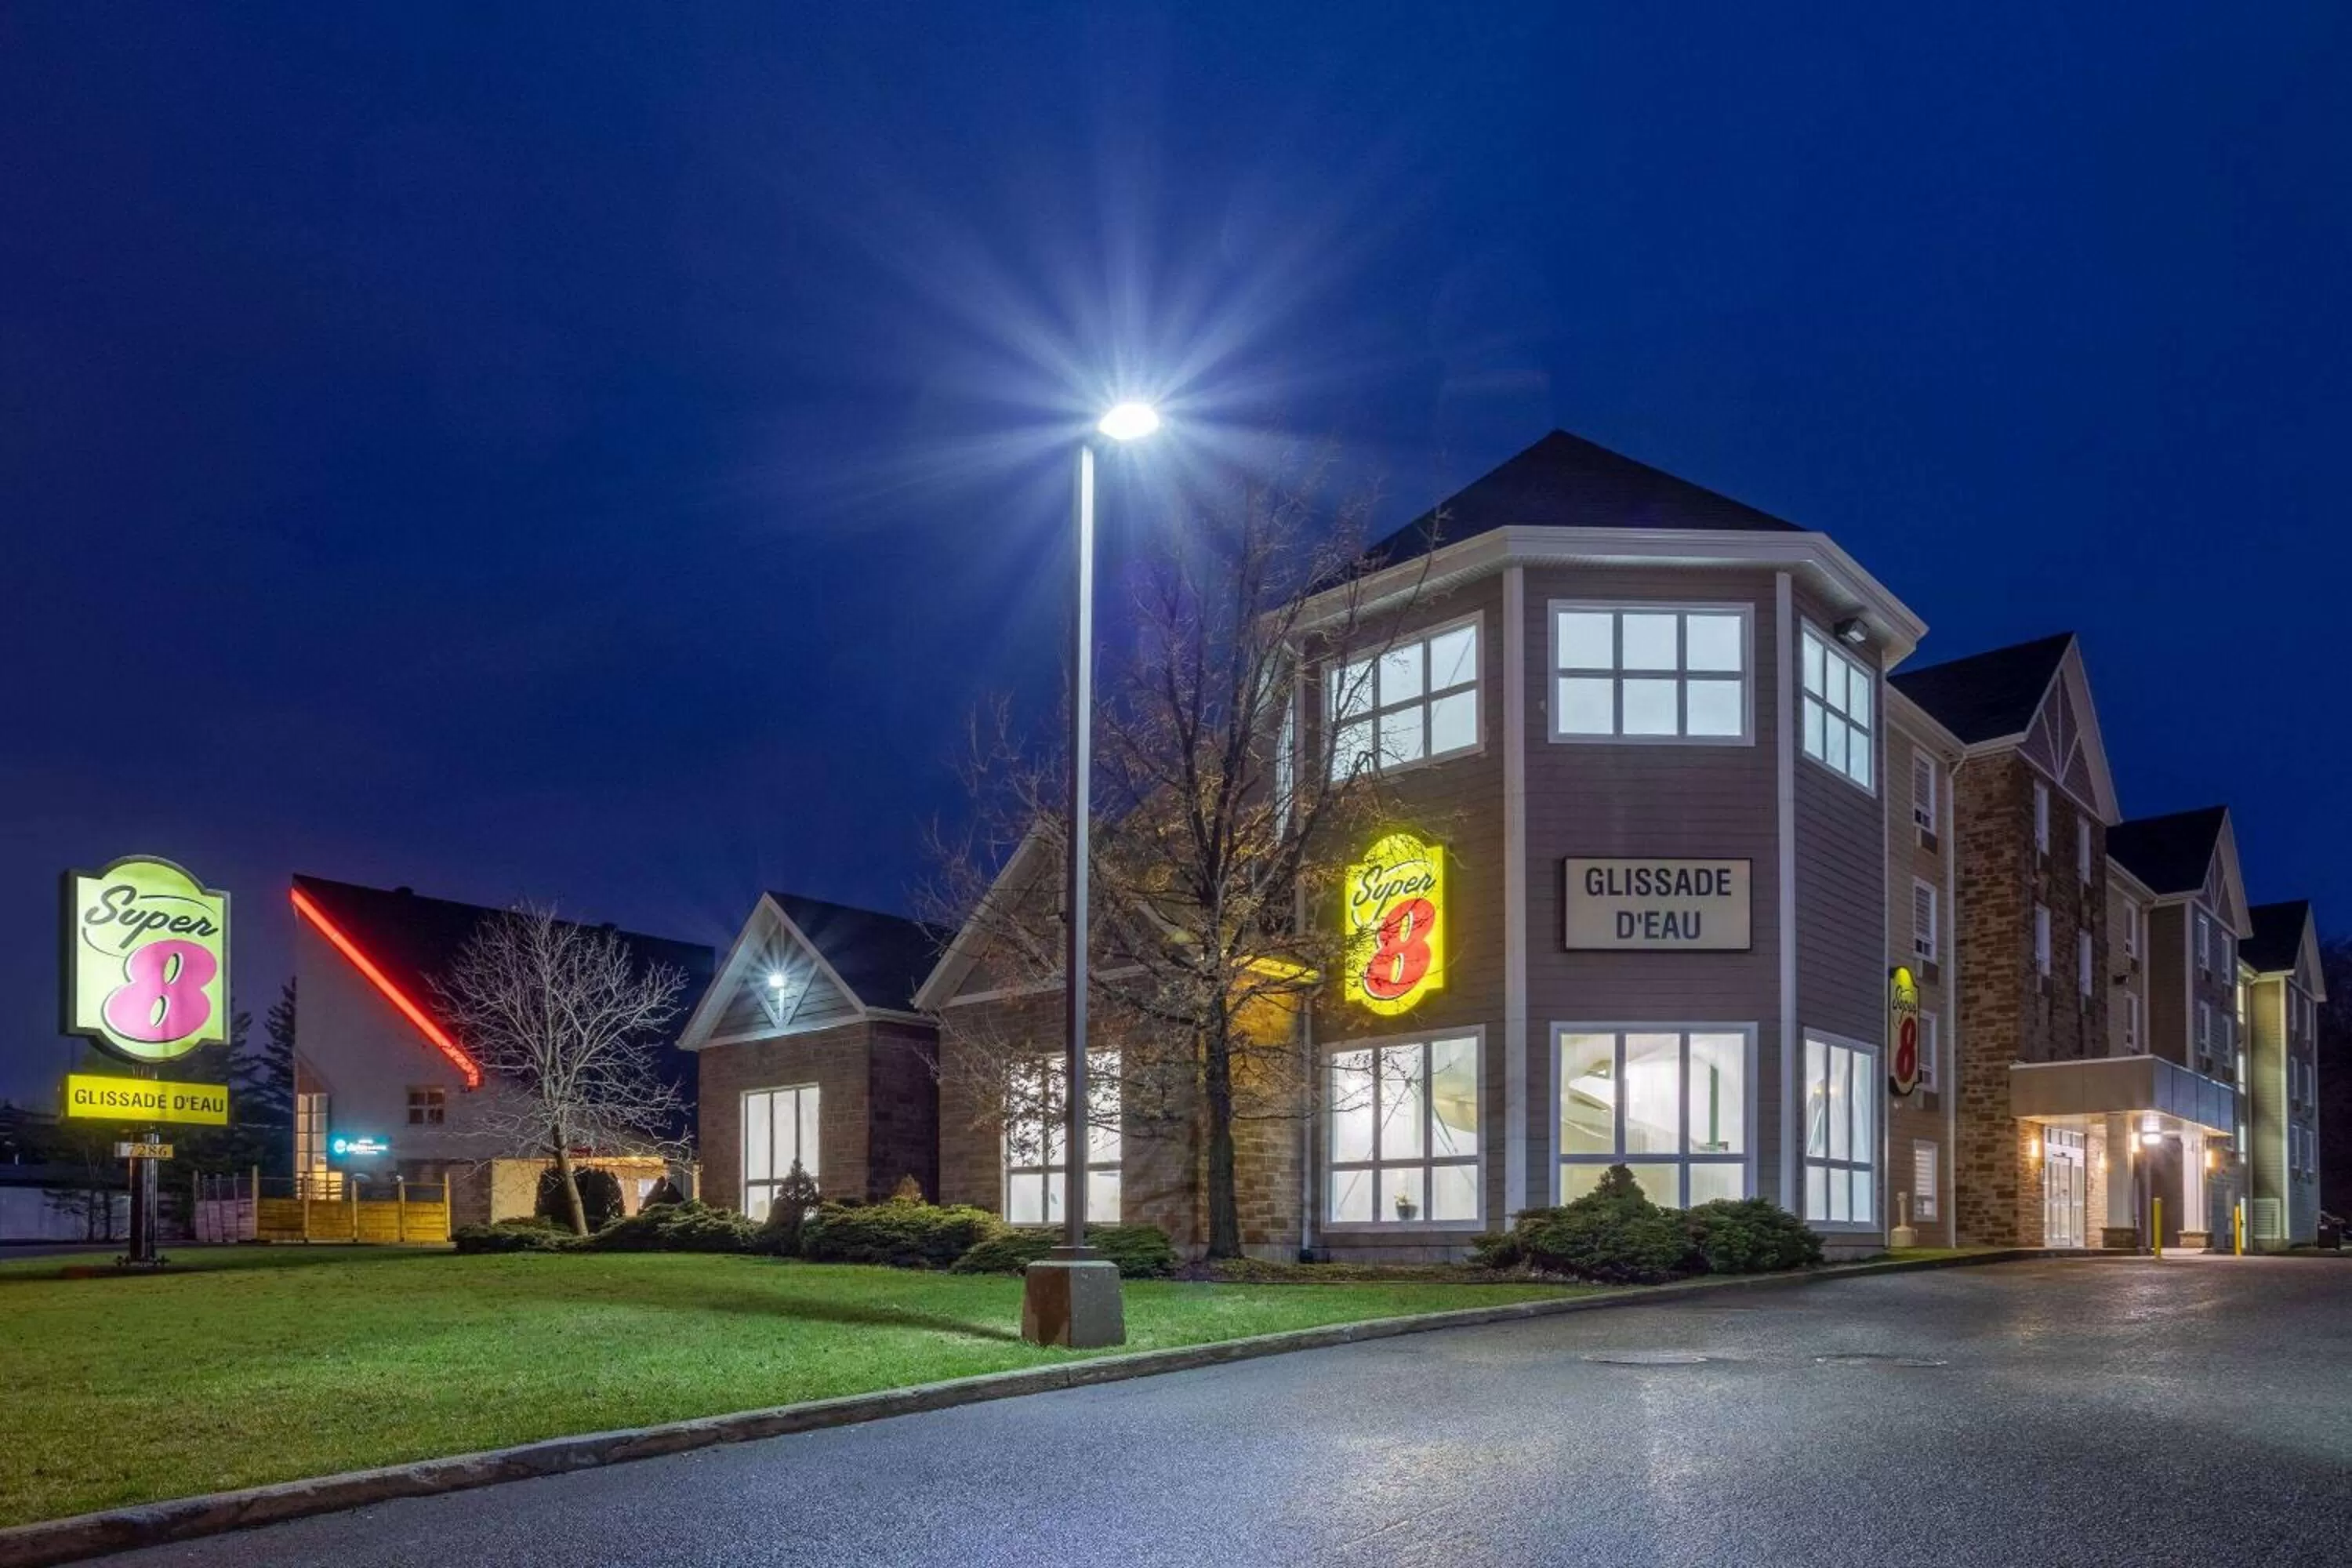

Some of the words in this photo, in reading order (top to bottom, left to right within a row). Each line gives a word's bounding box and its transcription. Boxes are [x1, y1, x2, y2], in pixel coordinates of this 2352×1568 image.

[1352, 865, 1436, 920] Super
[1584, 867, 1732, 896] GLISSADE
[84, 884, 218, 949] Super
[1616, 910, 1700, 939] D'EAU
[1363, 898, 1436, 1000] 8
[100, 938, 217, 1044] 8
[1896, 1017, 1916, 1083] 8
[74, 1088, 167, 1109] GLISSADE
[172, 1094, 223, 1112] D'EAU
